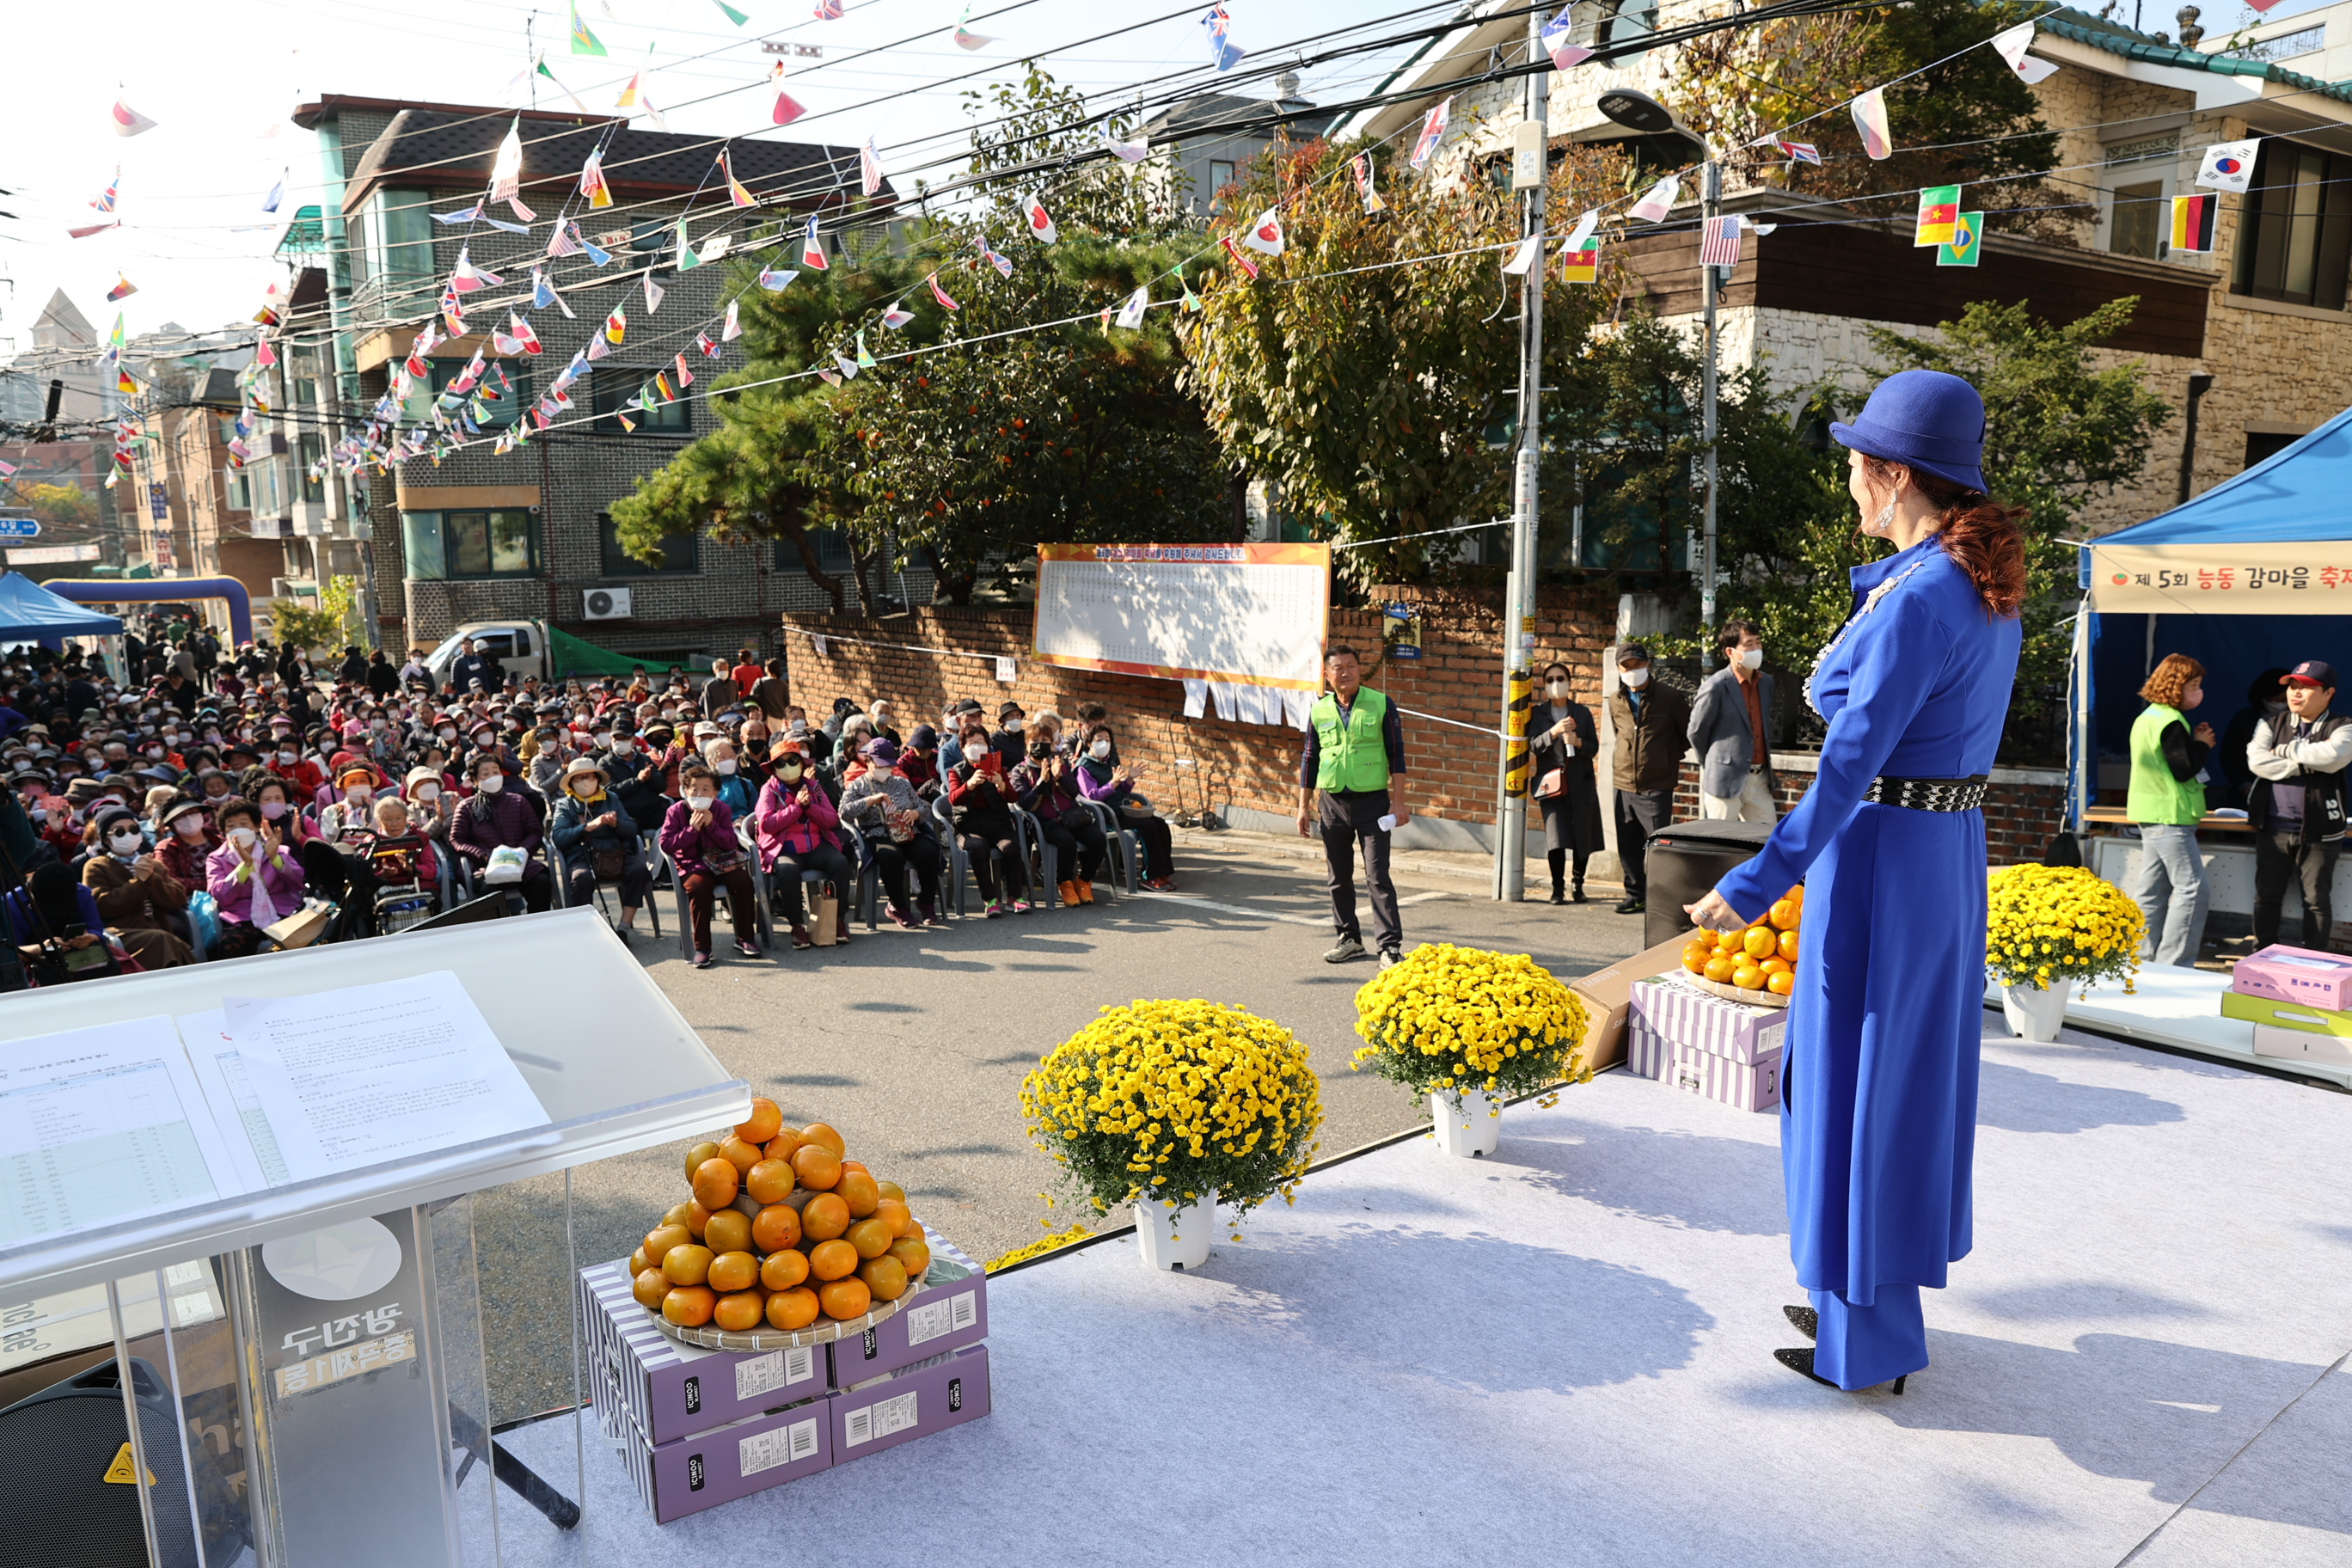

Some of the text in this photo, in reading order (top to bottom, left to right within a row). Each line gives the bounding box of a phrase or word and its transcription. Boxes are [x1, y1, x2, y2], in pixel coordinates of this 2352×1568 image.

[0, 521, 16, 530] 6길
[1184, 548, 1203, 560] 주셔서
[2135, 573, 2151, 586] 제
[2159, 570, 2189, 589] 5회
[2197, 567, 2235, 590] 능동
[2245, 567, 2310, 590] 감마을
[1508, 778, 1519, 789] kt
[1582, 969, 1620, 988] SAMSUNG
[686, 1382, 695, 1409] ICINOO
